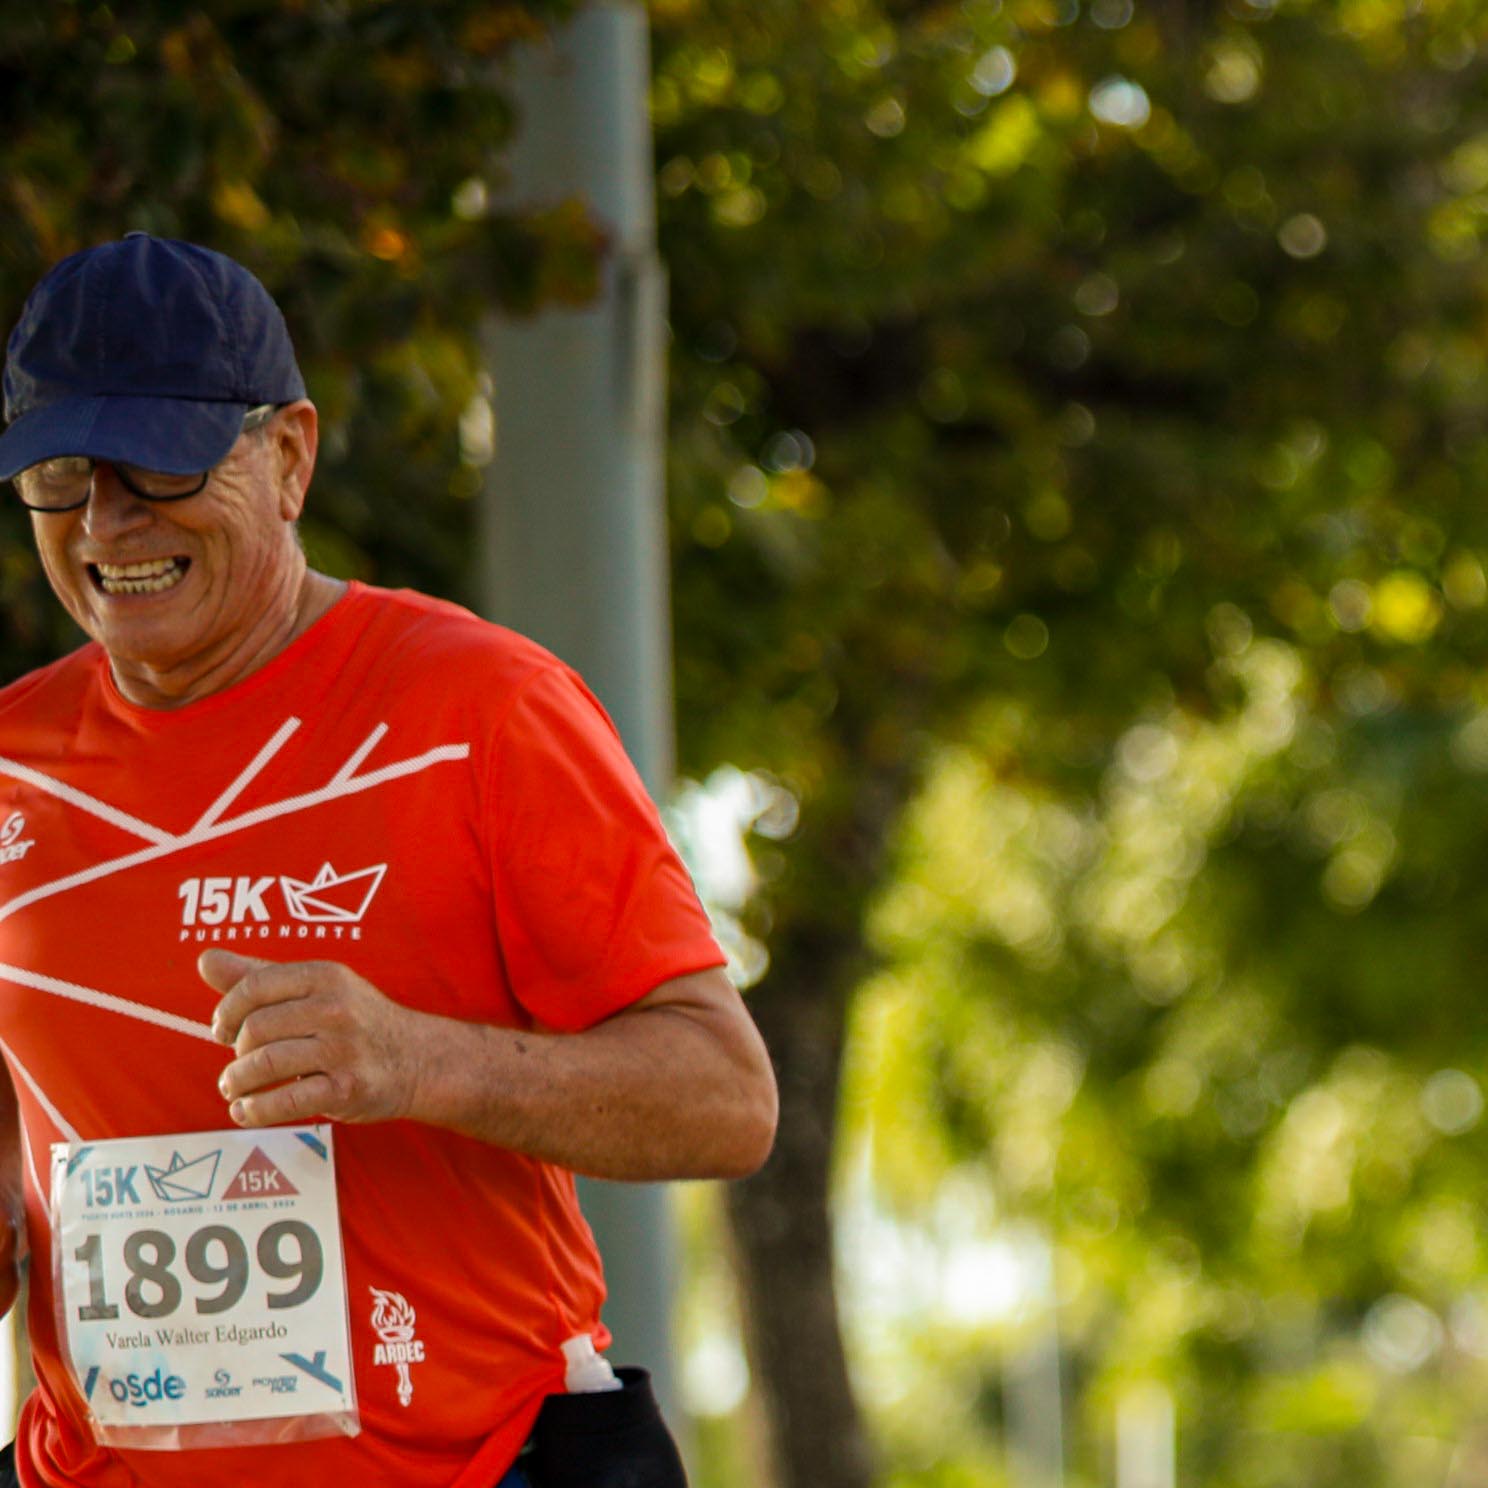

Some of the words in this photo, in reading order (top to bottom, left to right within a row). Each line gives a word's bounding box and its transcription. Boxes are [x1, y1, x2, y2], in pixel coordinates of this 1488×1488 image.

[178, 876, 276, 926] 15K
[179, 925, 270, 942] PUERTO
[279, 925, 361, 941] NORTE
[80, 1165, 141, 1207] 15K
[238, 1169, 281, 1193] 15K
[75, 1219, 324, 1322] 1899
[105, 1331, 150, 1350] Varela
[156, 1328, 210, 1346] Walter
[216, 1321, 288, 1346] Edgardo
[374, 1340, 426, 1366] ARDEC
